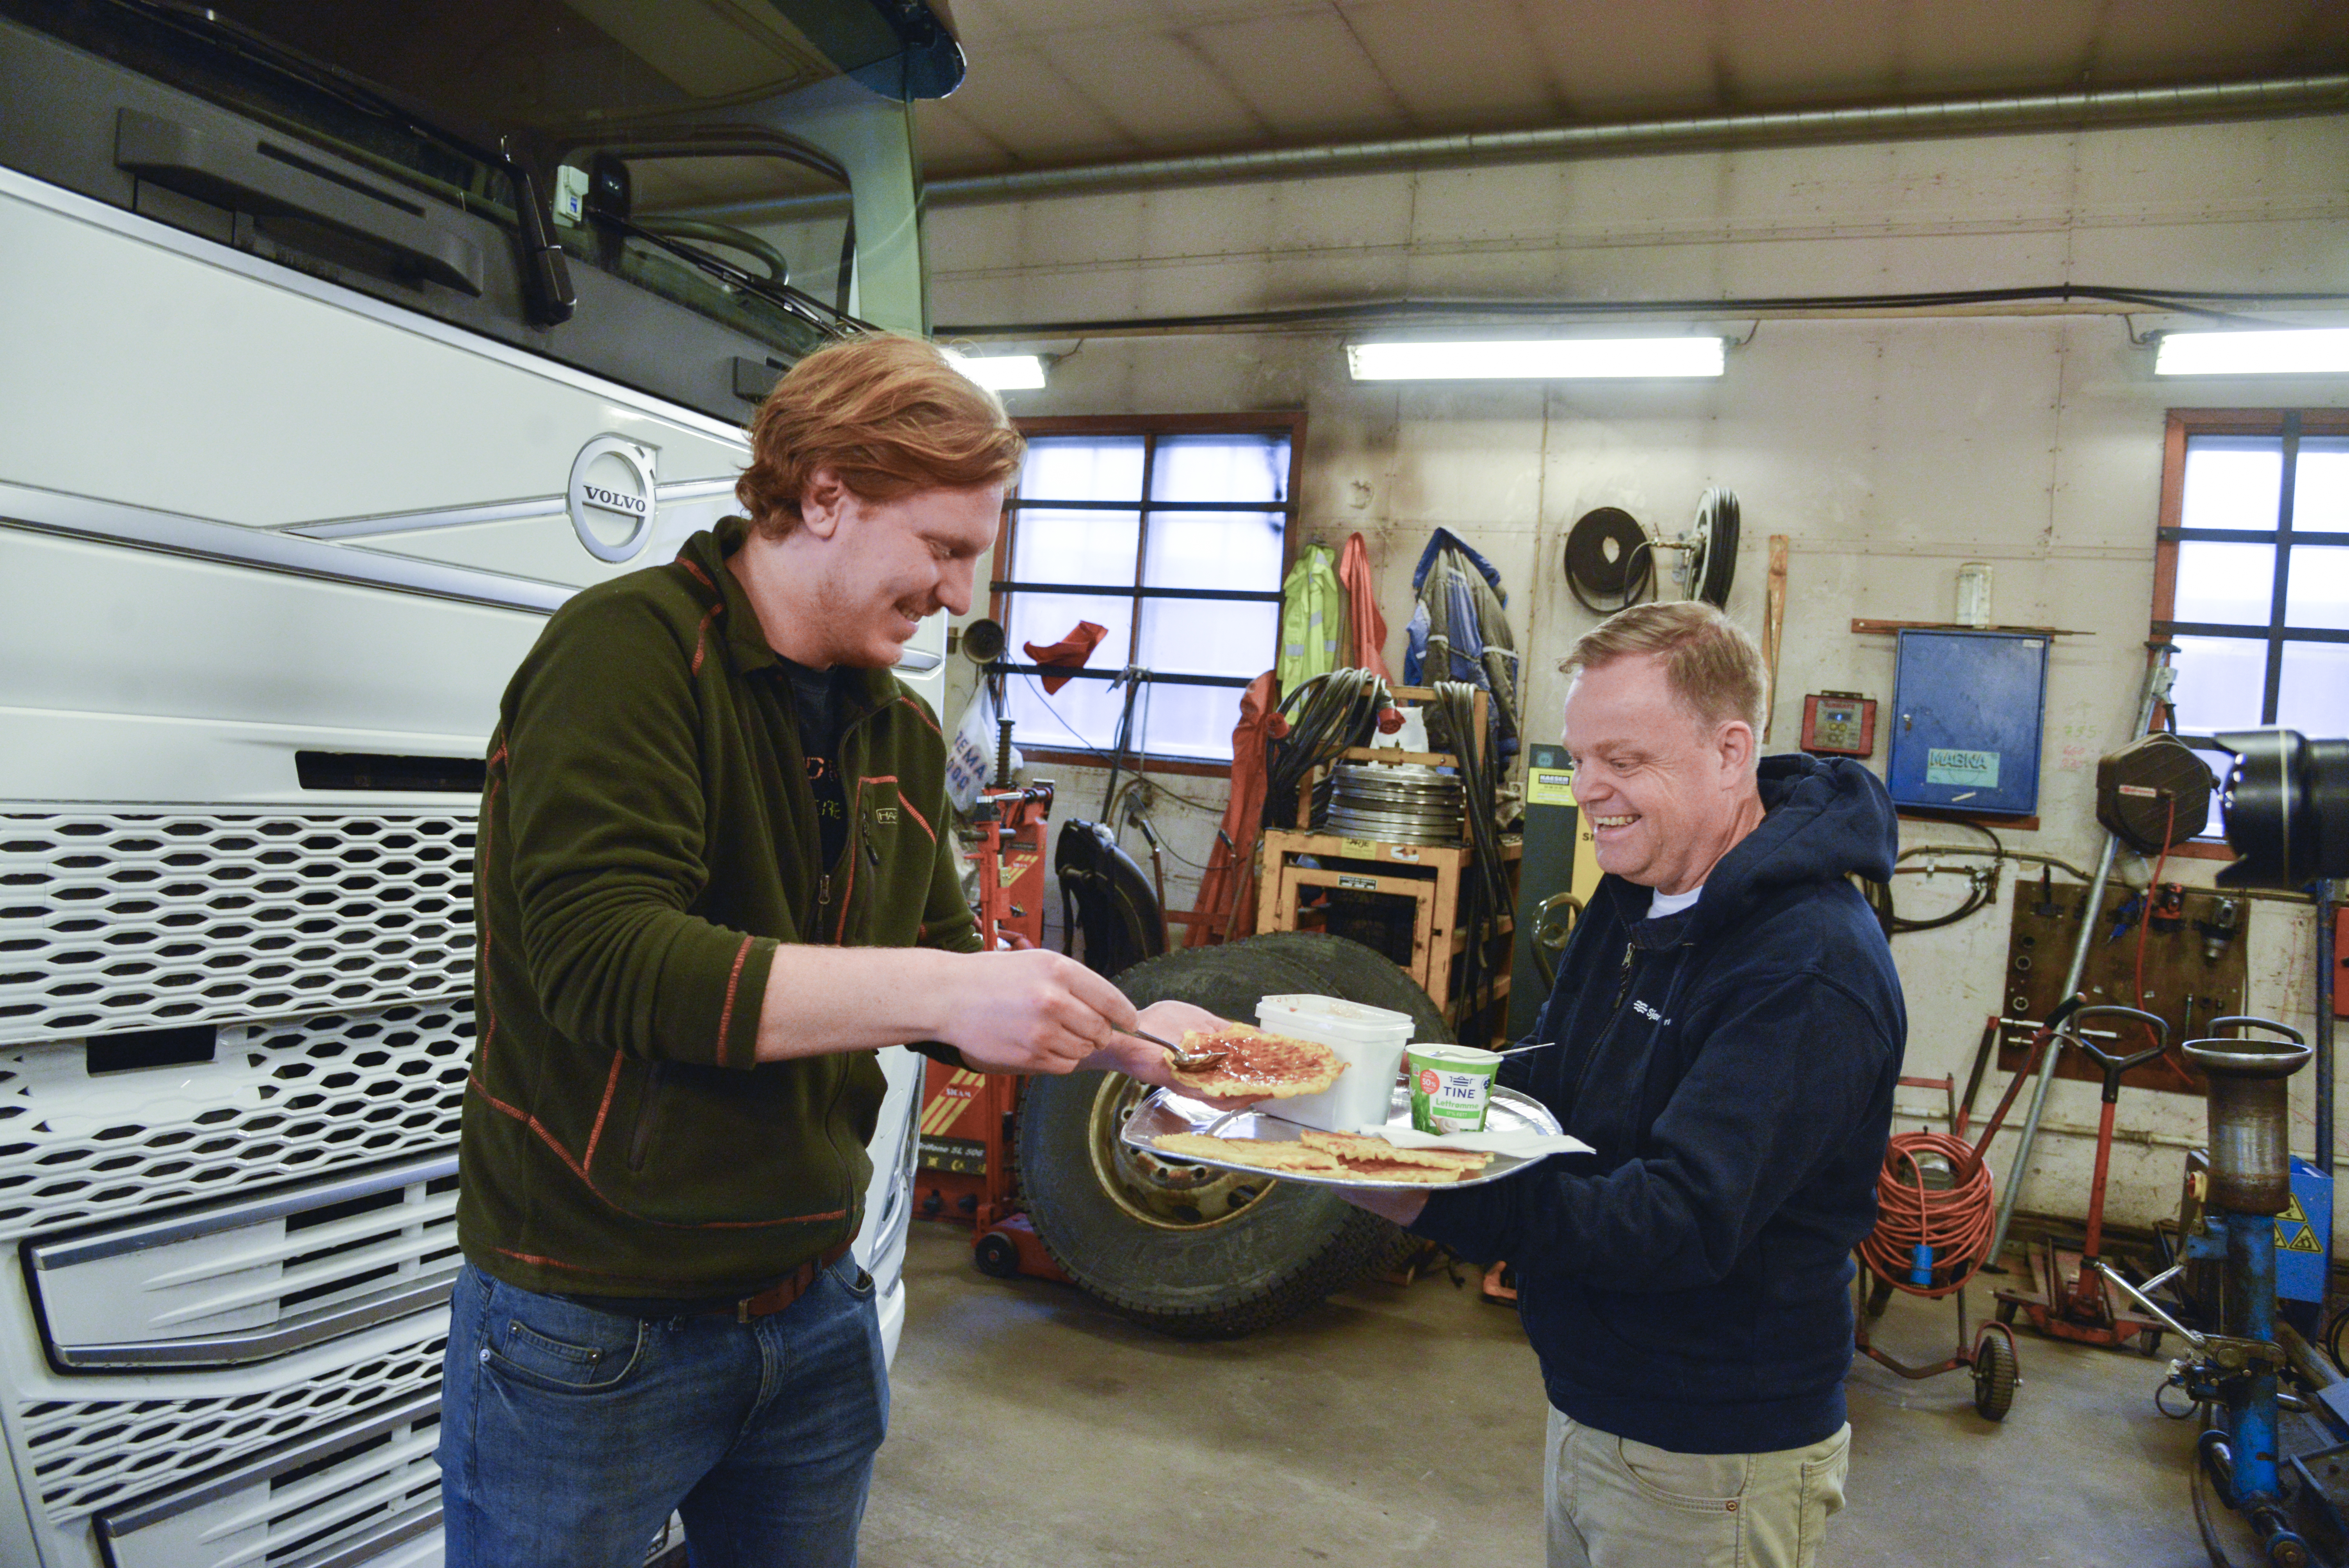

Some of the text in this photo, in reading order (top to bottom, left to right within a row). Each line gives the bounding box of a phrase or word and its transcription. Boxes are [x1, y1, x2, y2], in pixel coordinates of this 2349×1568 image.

[583, 485, 645, 512] VOLVO
[1444, 1086, 1476, 1098] TINE
[1436, 1098, 1479, 1109] Lettrømme
